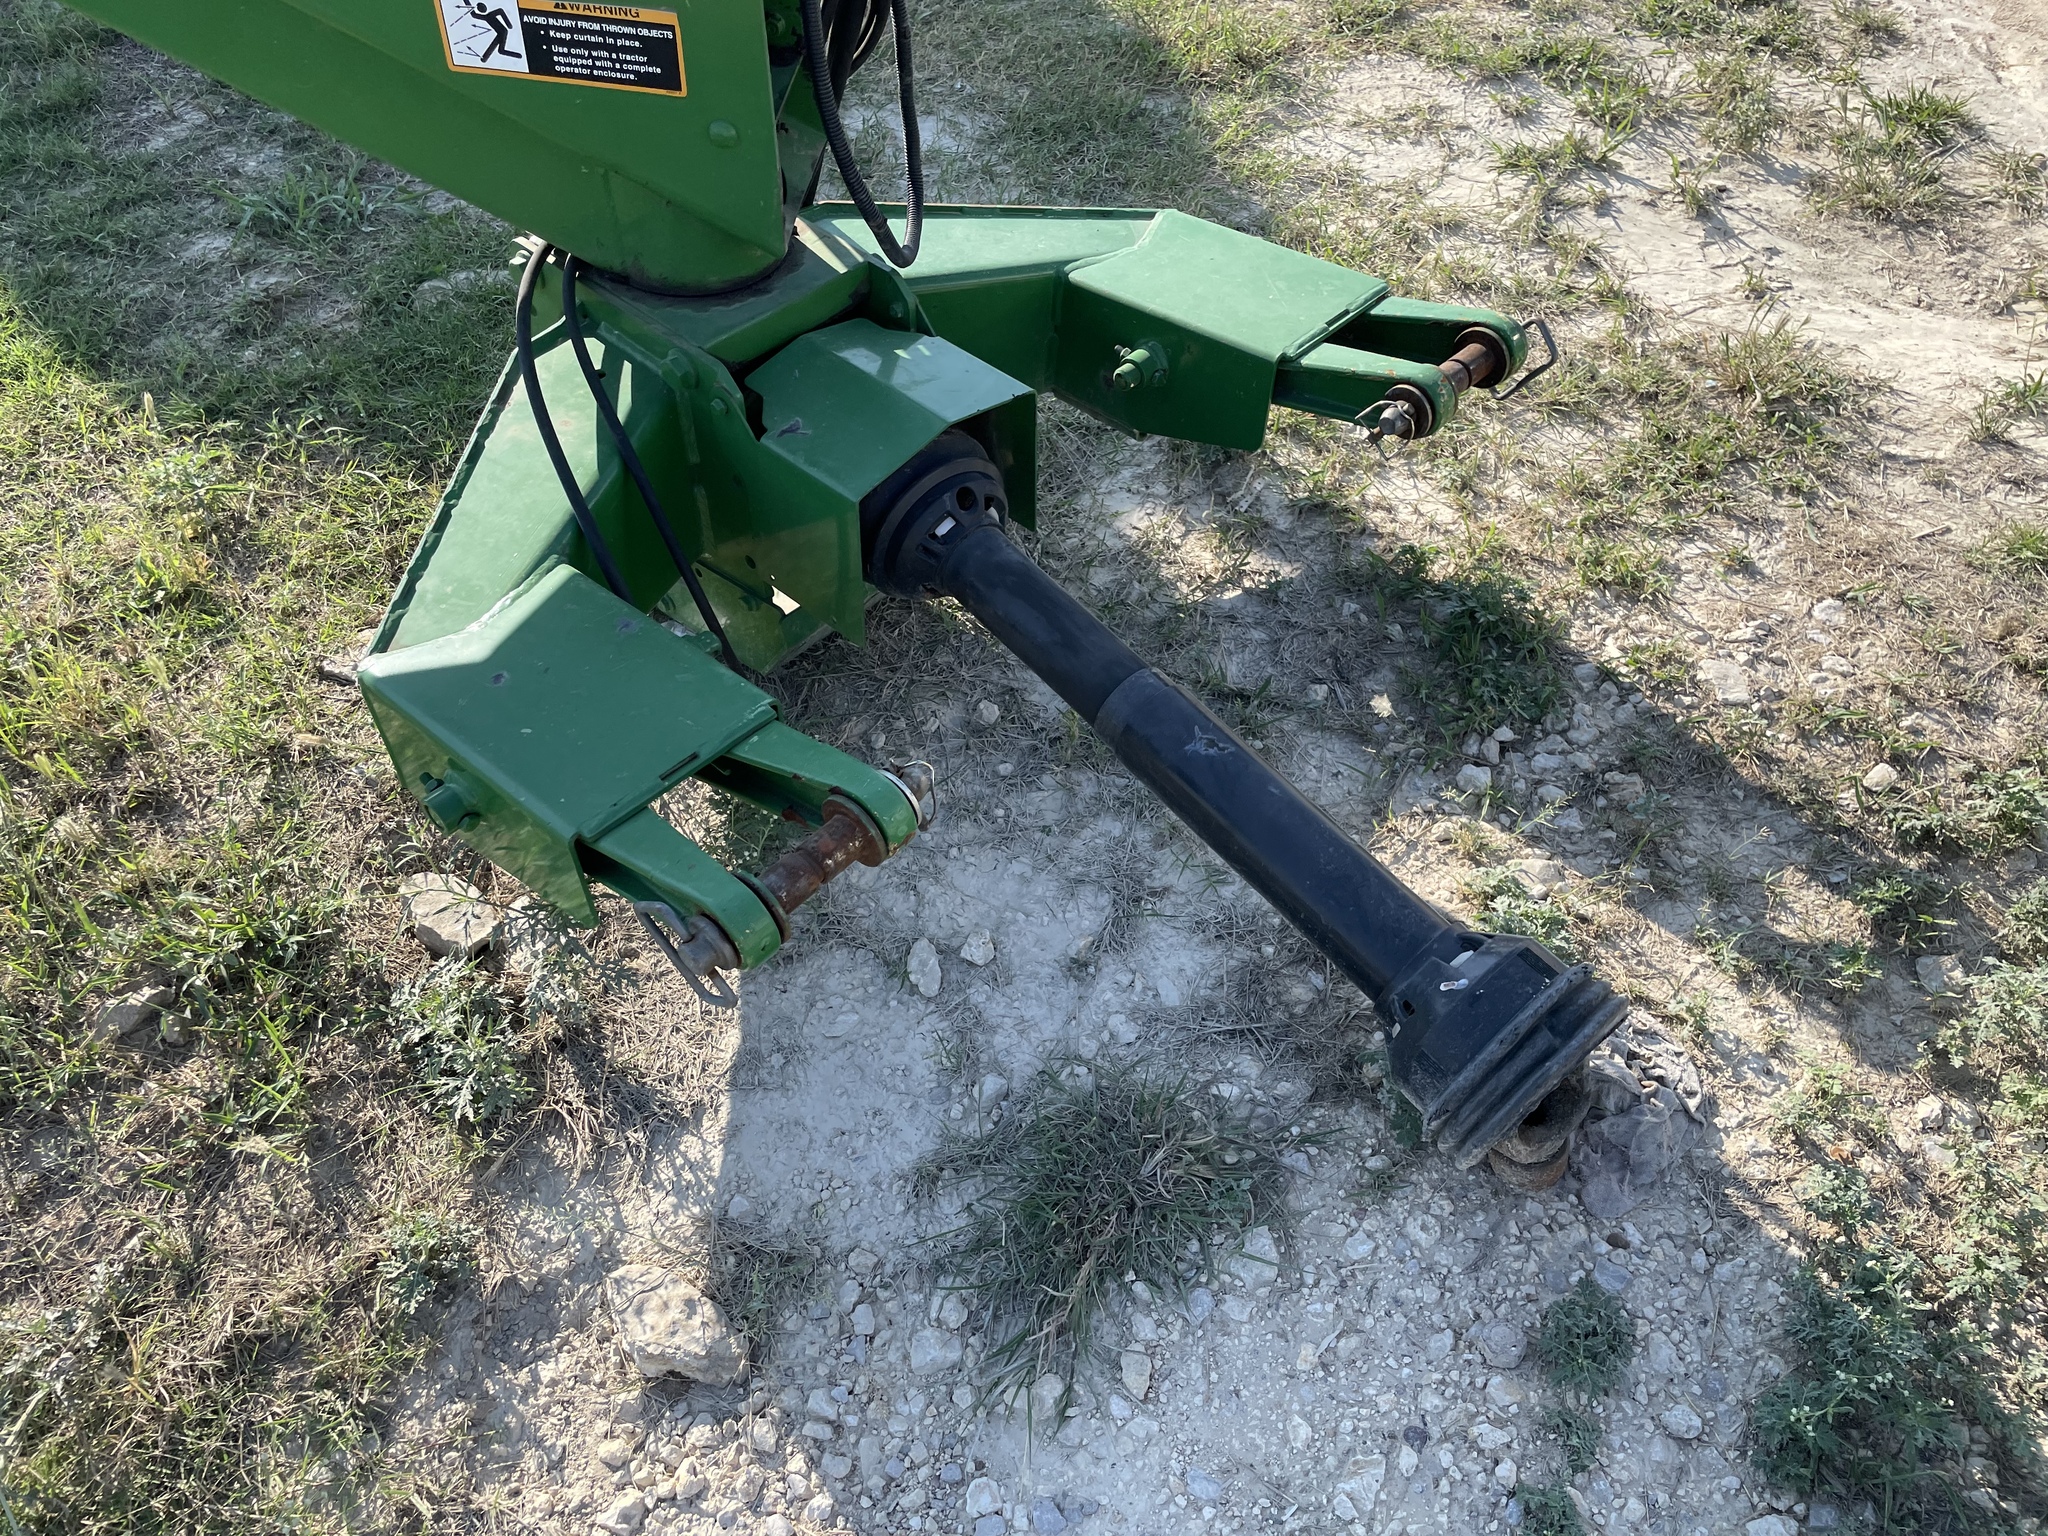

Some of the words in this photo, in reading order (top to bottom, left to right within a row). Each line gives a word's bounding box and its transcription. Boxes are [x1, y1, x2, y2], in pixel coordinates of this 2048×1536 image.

[568, 3, 640, 18] WARNING
[523, 15, 547, 24] AVOID
[548, 18, 576, 28] INJURY
[577, 21, 601, 31] FROM
[601, 24, 636, 35] THROWN
[637, 28, 673, 39] OBJECTS
[549, 30, 571, 41] Keep
[573, 34, 604, 43] curtain
[606, 36, 615, 44] in
[617, 38, 643, 48] place.
[551, 45, 568, 53] Use
[570, 48, 589, 57] only
[591, 50, 609, 58] with
[619, 53, 648, 62] tractor
[553, 55, 593, 66] equipped
[595, 60, 613, 68] with
[622, 63, 662, 73] complete
[555, 65, 591, 74] operator
[593, 69, 638, 80] enclosure.
